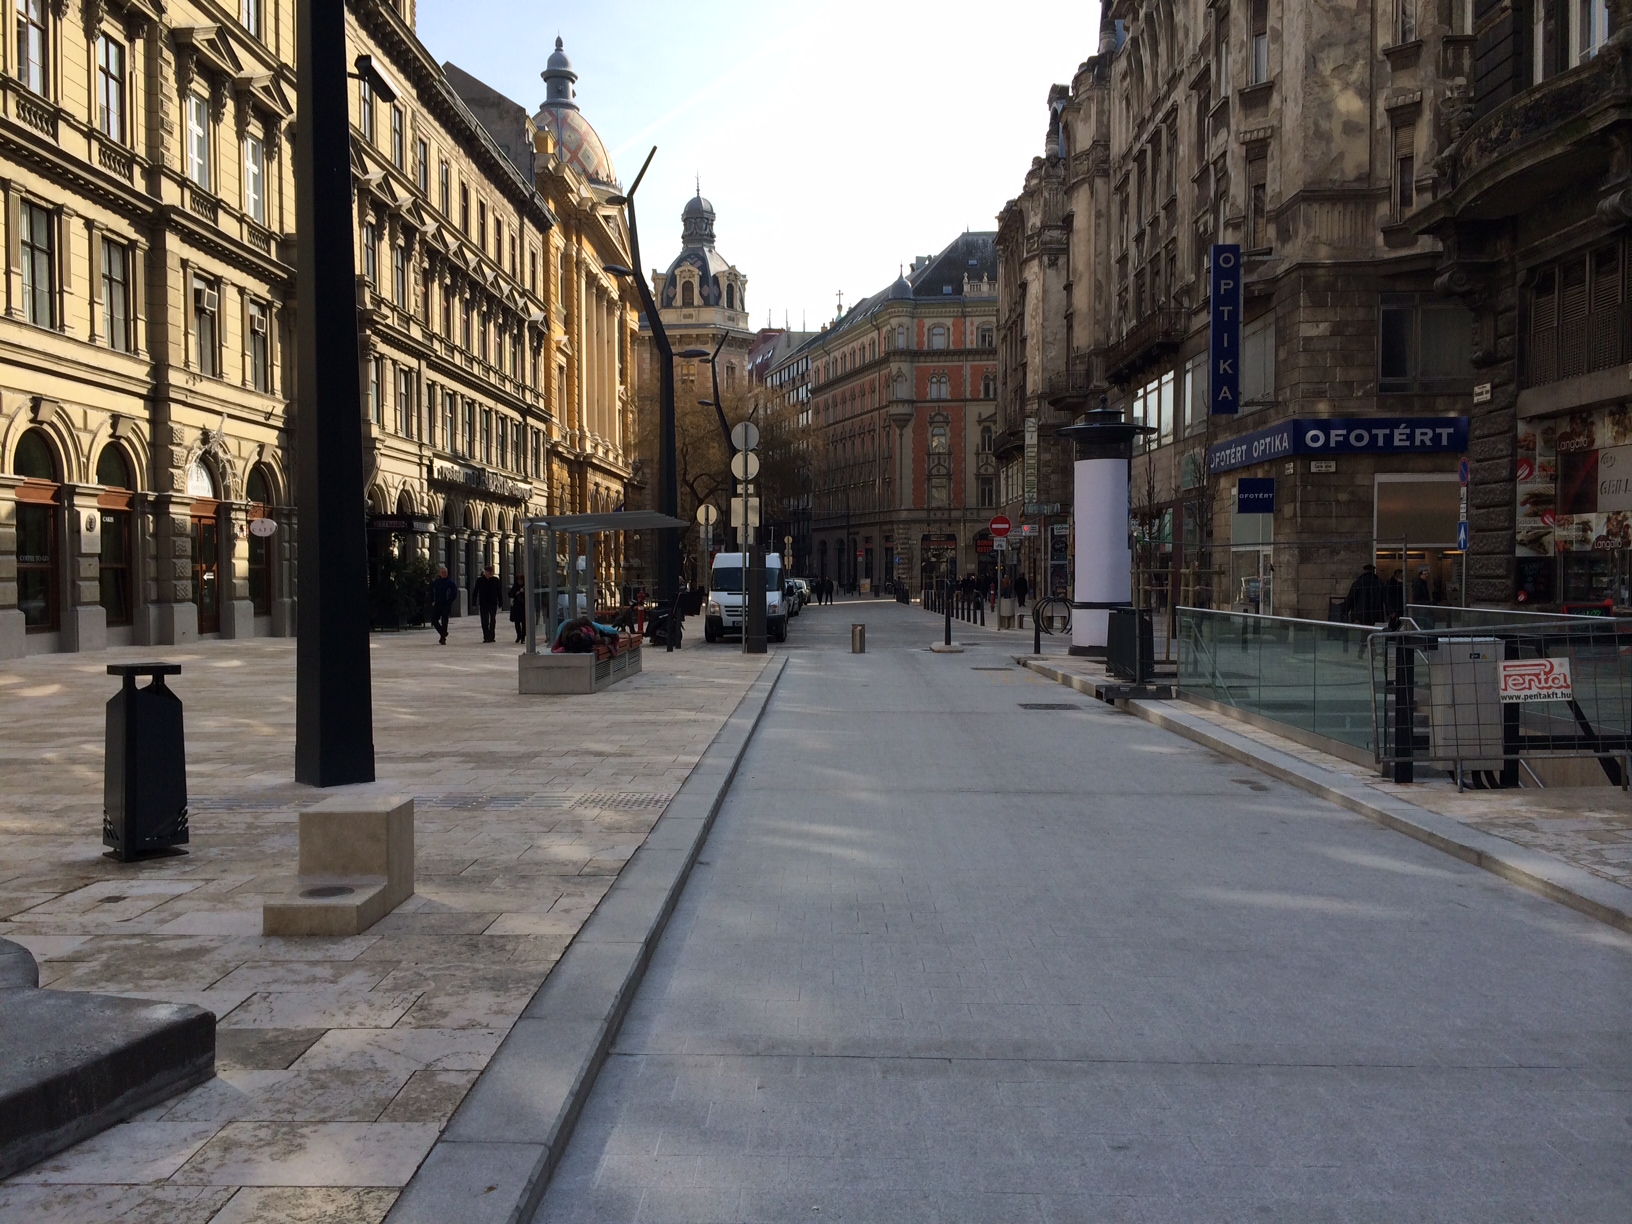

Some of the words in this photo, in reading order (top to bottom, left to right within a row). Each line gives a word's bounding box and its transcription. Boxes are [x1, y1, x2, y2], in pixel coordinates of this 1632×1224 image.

[1217, 253, 1235, 401] OPTIKA
[1210, 443, 1247, 469] OFOTÉRT
[1252, 432, 1289, 458] OPTIKA
[1304, 424, 1455, 448] OFOTÉRT
[1500, 660, 1571, 691] Penta
[1500, 691, 1571, 702] www.pentakft.hu
